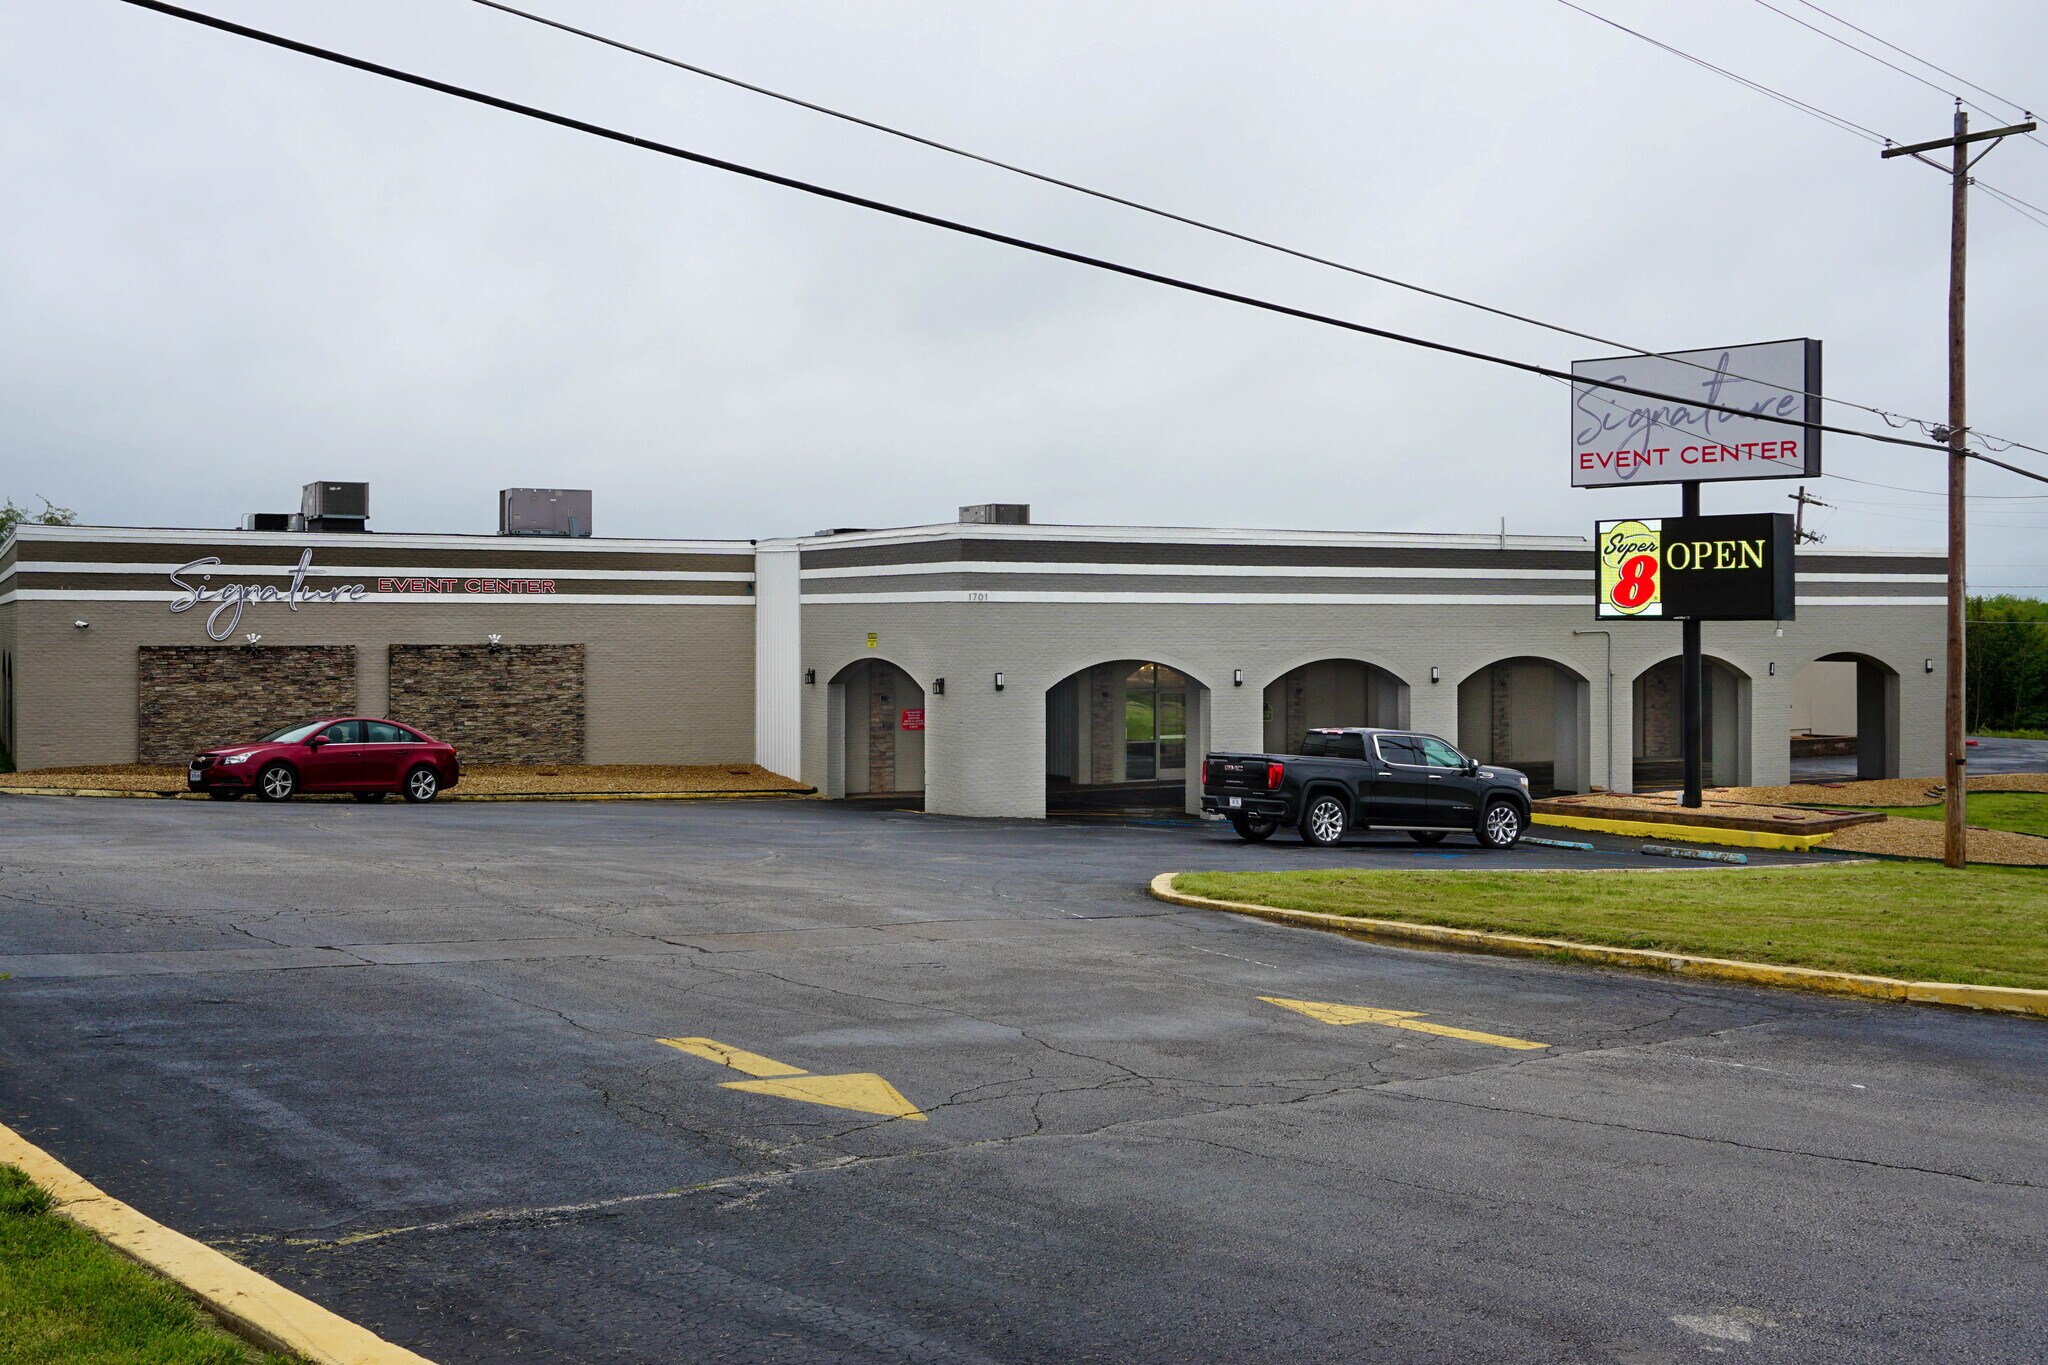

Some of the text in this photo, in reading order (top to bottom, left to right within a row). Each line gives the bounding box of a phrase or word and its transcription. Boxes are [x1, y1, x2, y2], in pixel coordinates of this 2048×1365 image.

[1576, 351, 1800, 480] Signature
[1579, 440, 1798, 470] EVENT CENTER
[1603, 532, 1658, 565] Super
[1666, 539, 1766, 570] OPEN
[169, 547, 371, 642] Signature
[377, 577, 556, 595] EVENT CENTER
[968, 593, 988, 601] 1701
[1610, 554, 1659, 608] 8
